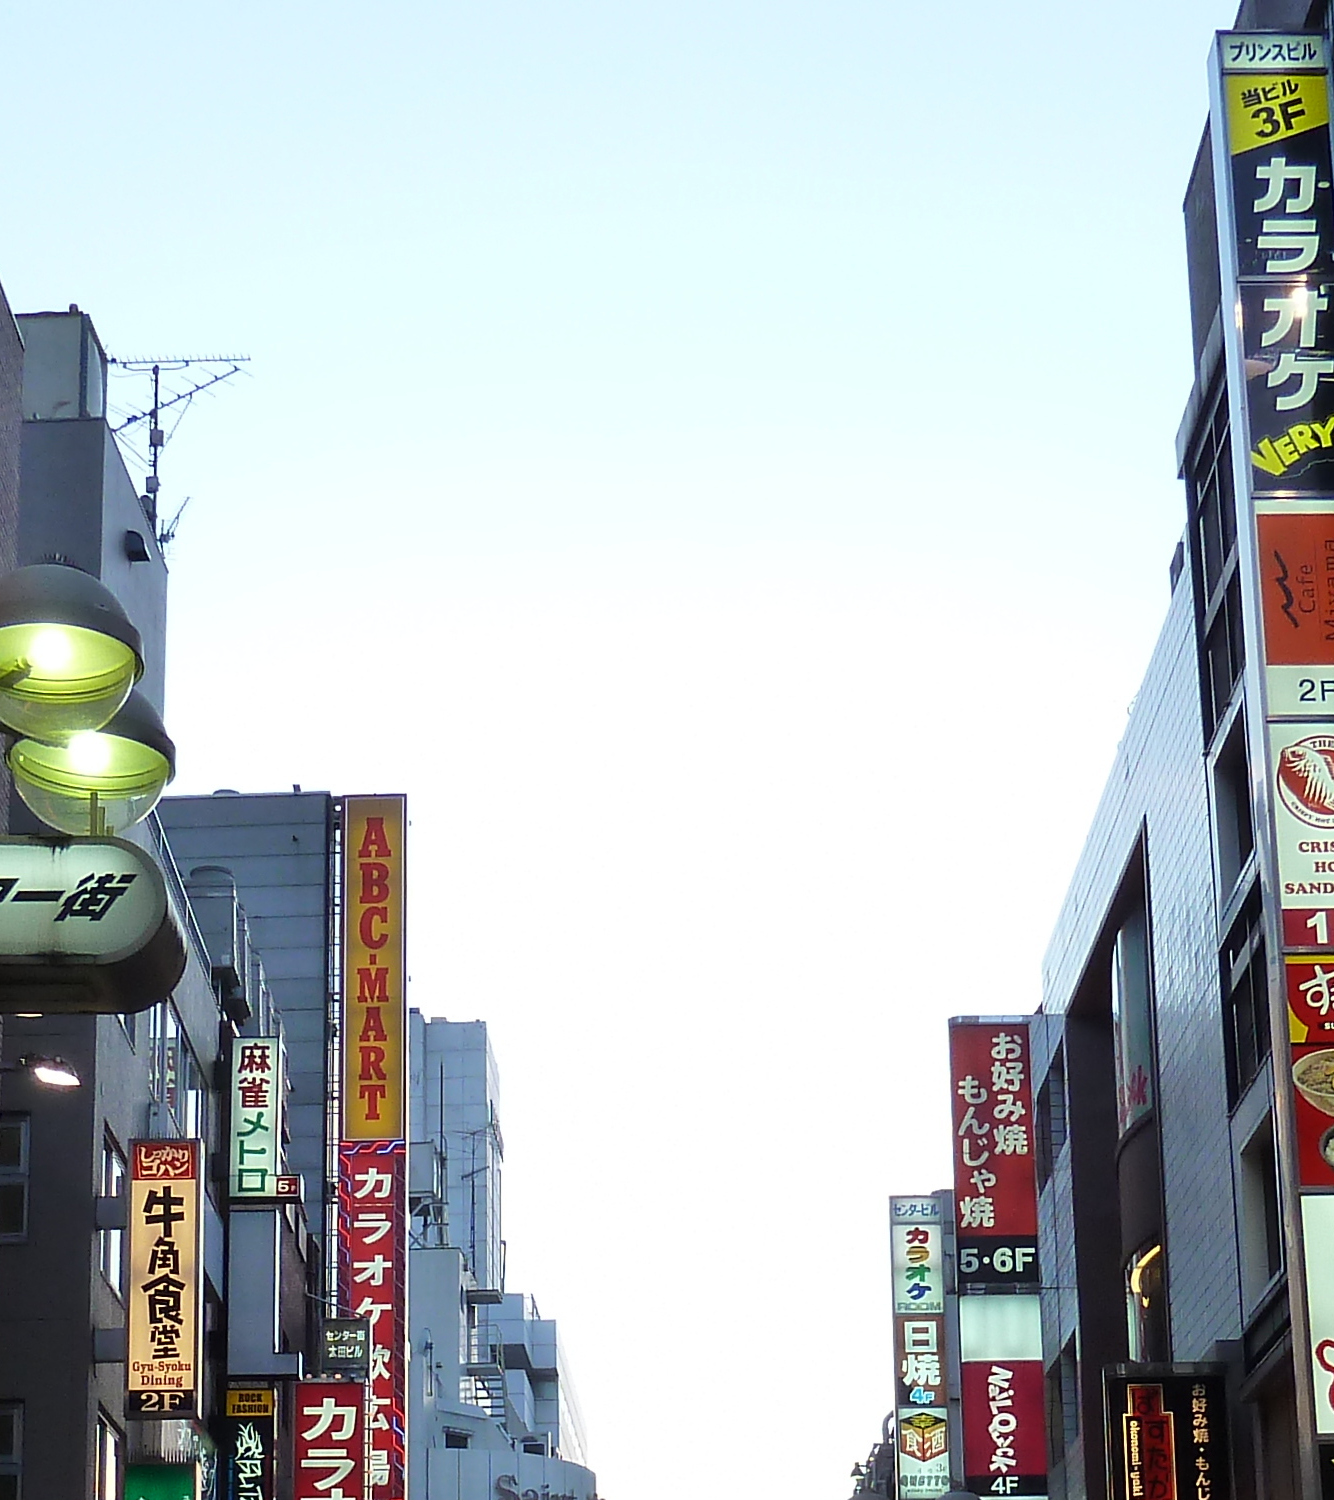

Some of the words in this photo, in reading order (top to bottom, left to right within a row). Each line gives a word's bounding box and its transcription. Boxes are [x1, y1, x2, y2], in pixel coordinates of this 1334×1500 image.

[1229, 41, 1317, 63] プリンスビル
[1241, 79, 1299, 107] 当ビル
[1251, 98, 1305, 138] 3F
[1254, 157, 1334, 411] カラオケ
[1299, 562, 1314, 614] Cafe
[1309, 740, 1334, 750] THE
[357, 817, 391, 1120] ABC-MART
[991, 1032, 1028, 1155] お好み焼
[237, 1044, 271, 1193] 麻雀メトロ
[958, 1076, 996, 1228] もんじゃ焼
[142, 1160, 190, 1177] ゴハン
[277, 1181, 296, 1193] 5F
[893, 1203, 939, 1217] センタービル
[141, 1185, 186, 1359] 牛角食堂
[905, 1227, 933, 1301] カラオケ
[325, 1330, 365, 1342] センター街
[901, 1319, 941, 1385] 日焼
[132, 1360, 191, 1375] Gyu-Syoku
[141, 1374, 183, 1388] Dining
[140, 1394, 181, 1412] 2F
[238, 1392, 262, 1403] ROCK
[909, 1387, 934, 1403] 4F
[231, 1402, 269, 1414] FASHION
[991, 1476, 1018, 1494] 4F
